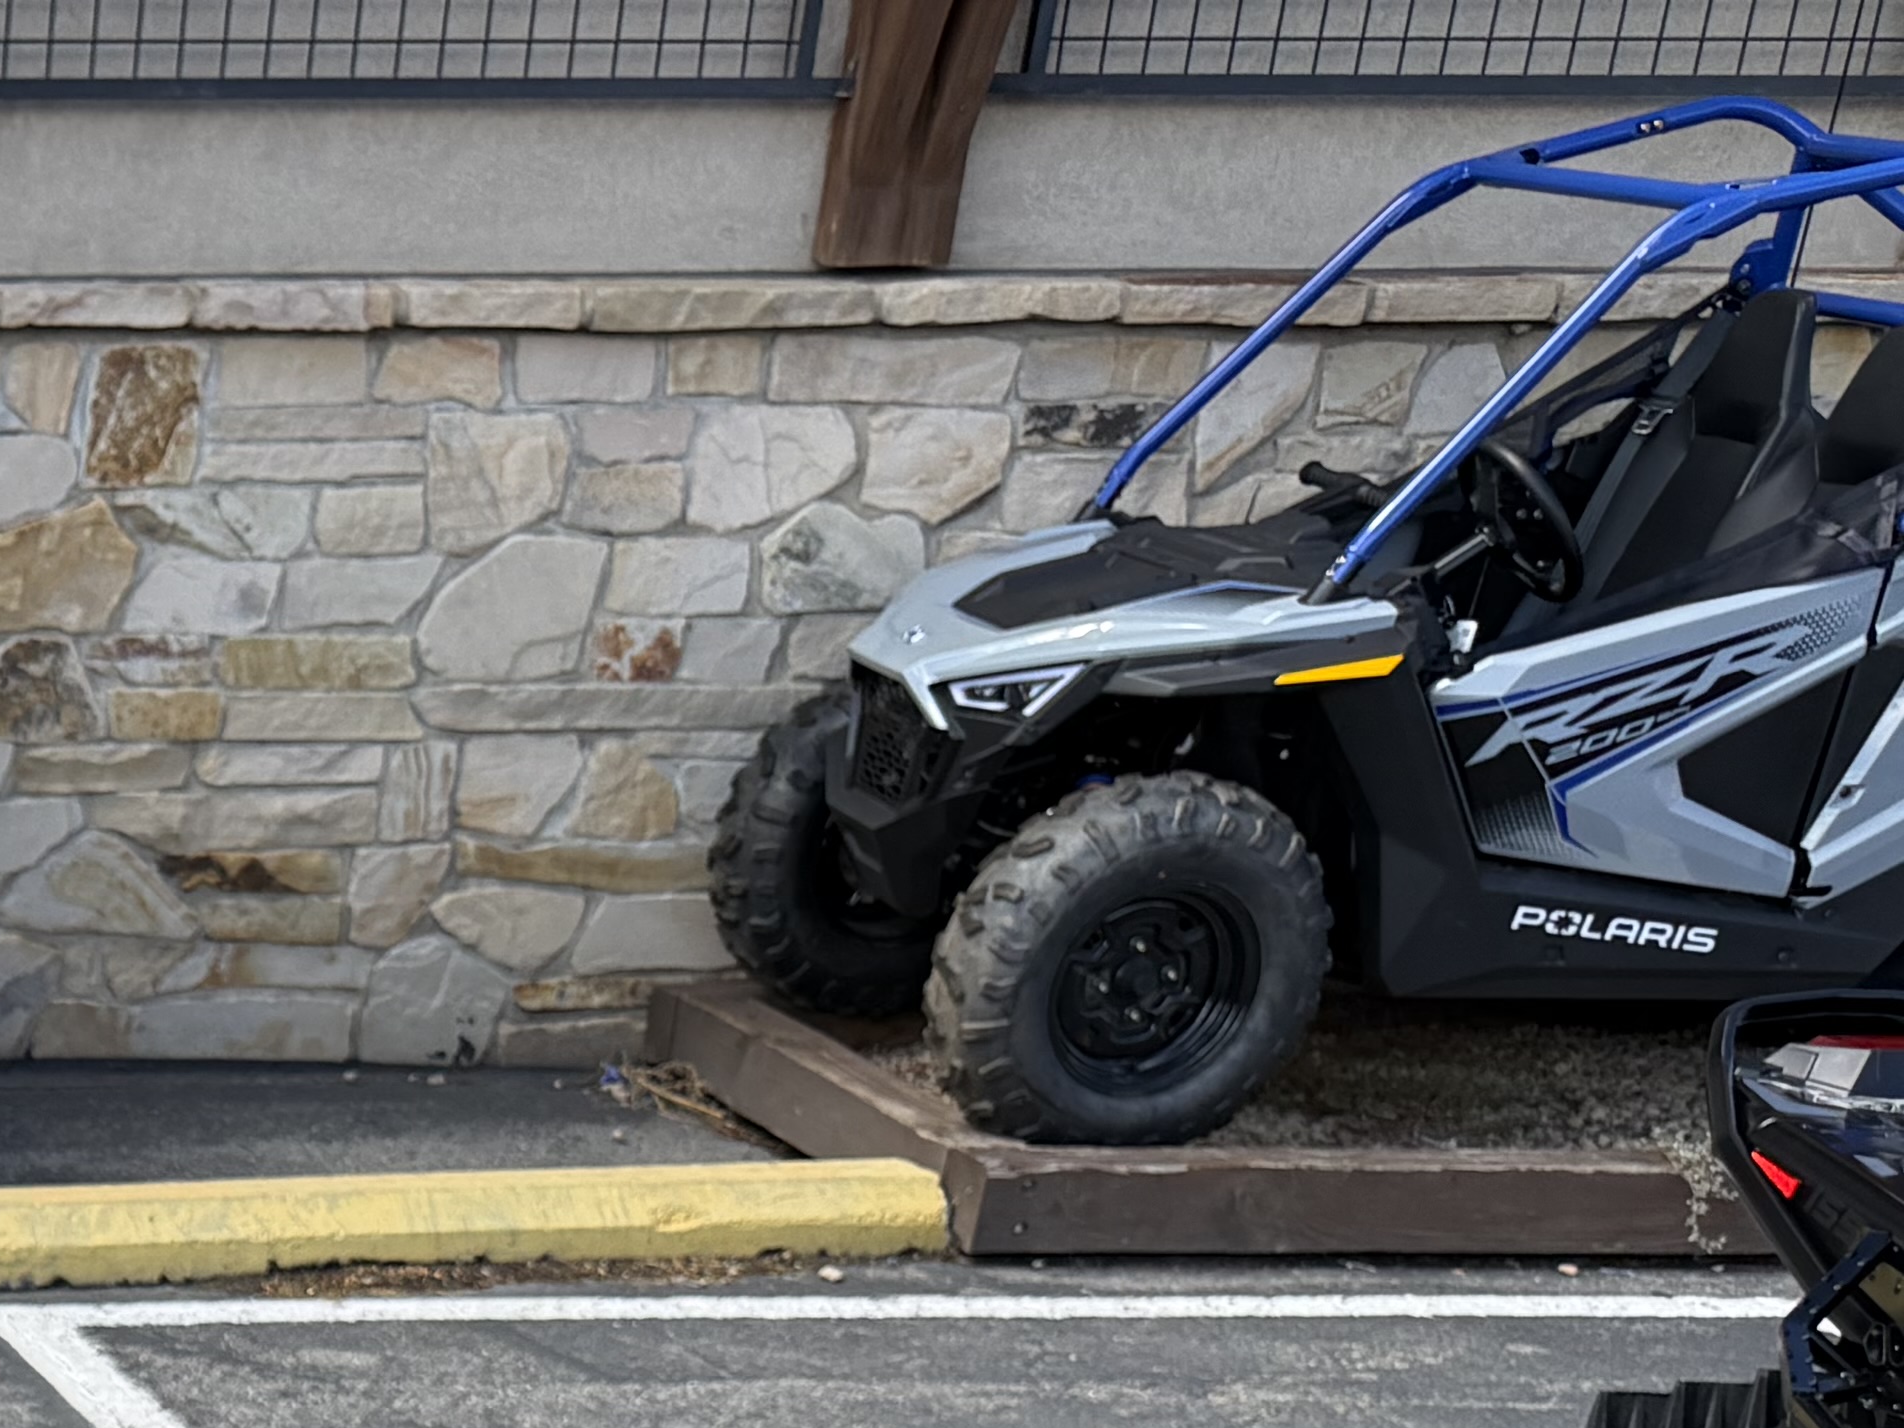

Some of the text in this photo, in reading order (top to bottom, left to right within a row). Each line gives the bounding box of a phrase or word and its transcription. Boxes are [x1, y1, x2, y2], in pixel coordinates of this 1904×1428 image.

[1464, 624, 1810, 767] RZR
[1546, 717, 1655, 765] 200
[1509, 904, 1719, 954] POLARIS
